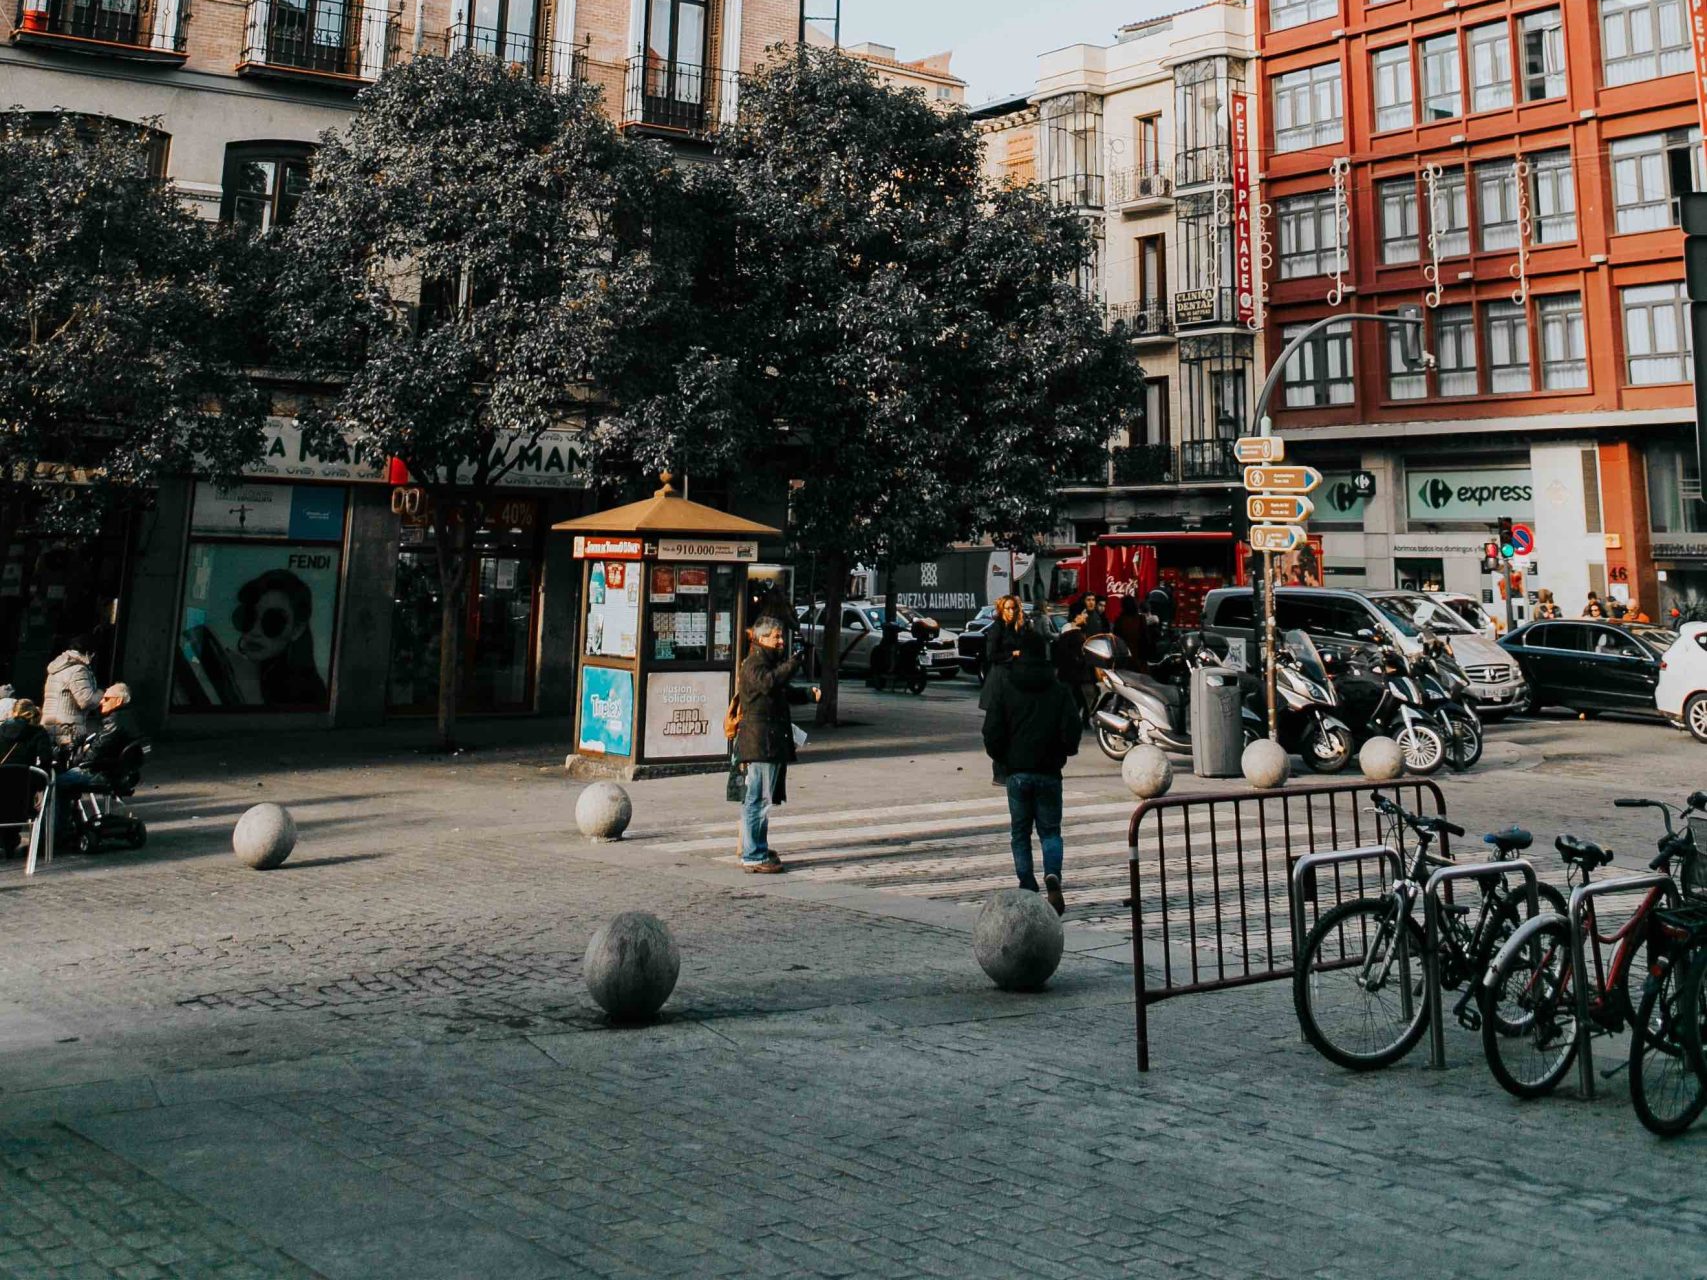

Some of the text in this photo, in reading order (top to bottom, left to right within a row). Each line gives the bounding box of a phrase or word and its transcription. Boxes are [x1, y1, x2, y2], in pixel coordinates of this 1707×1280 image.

[1235, 101, 1250, 288] PETIT PALACE
[1177, 300, 1213, 312] DENTAL
[1457, 484, 1533, 506] express
[502, 501, 533, 525] 40%
[676, 544, 715, 556] 910.000
[288, 554, 331, 569] FENDI
[1609, 566, 1628, 581] 46
[929, 593, 976, 610] ALHAMBRA
[673, 709, 699, 722] EURO
[664, 720, 709, 735] JACKPOT
